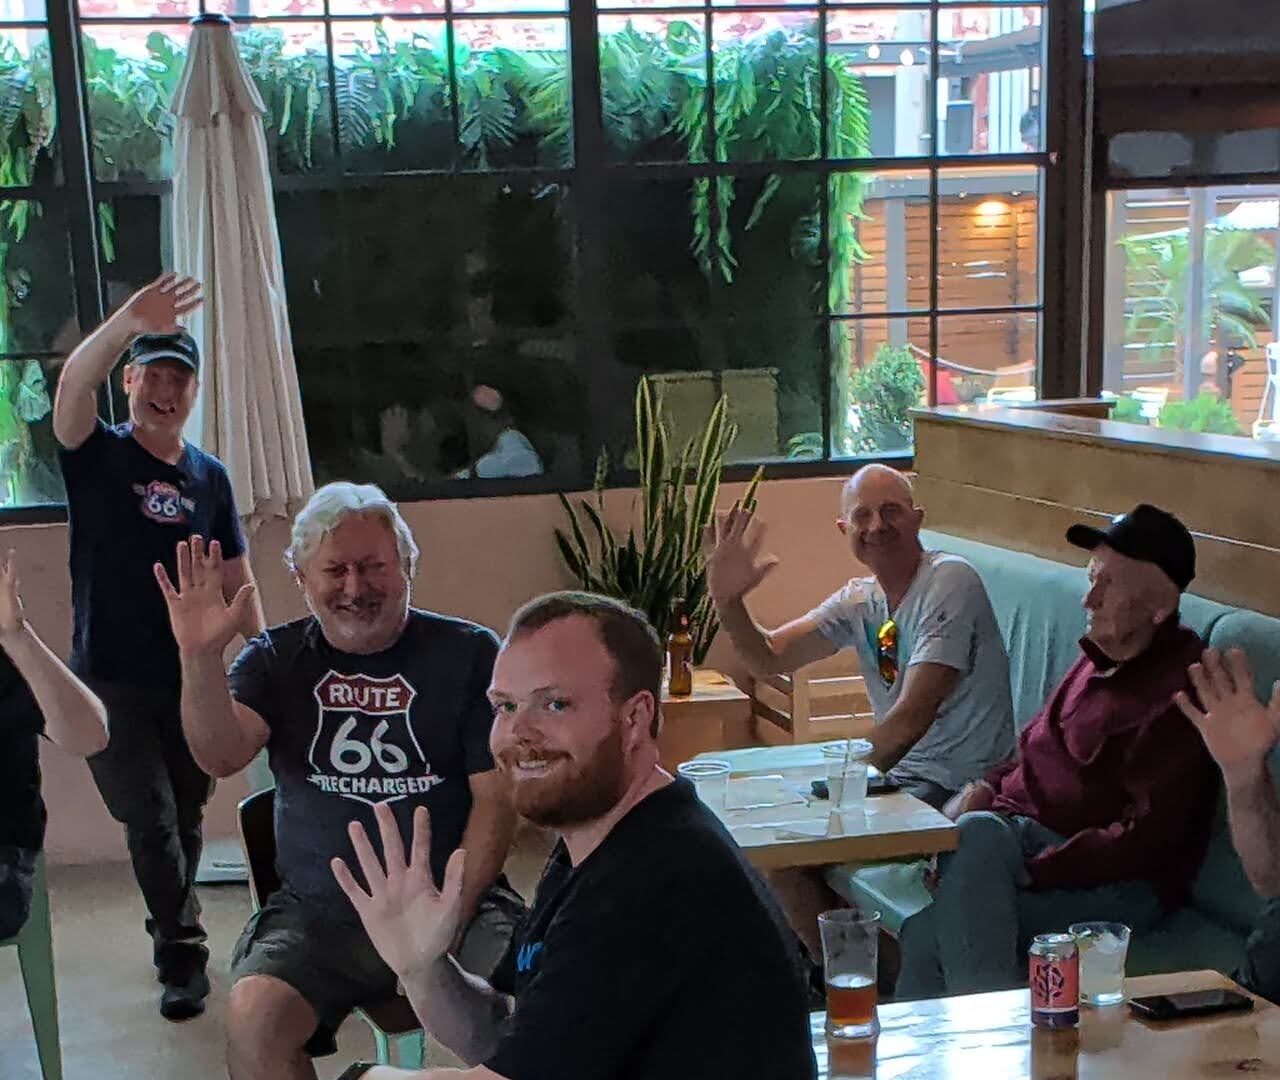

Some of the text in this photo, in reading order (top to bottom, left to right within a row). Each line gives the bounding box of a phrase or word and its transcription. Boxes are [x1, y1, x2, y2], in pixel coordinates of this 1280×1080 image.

[148, 493, 177, 516] 66
[330, 715, 409, 774] 66
[320, 774, 431, 794] RECHARGED
